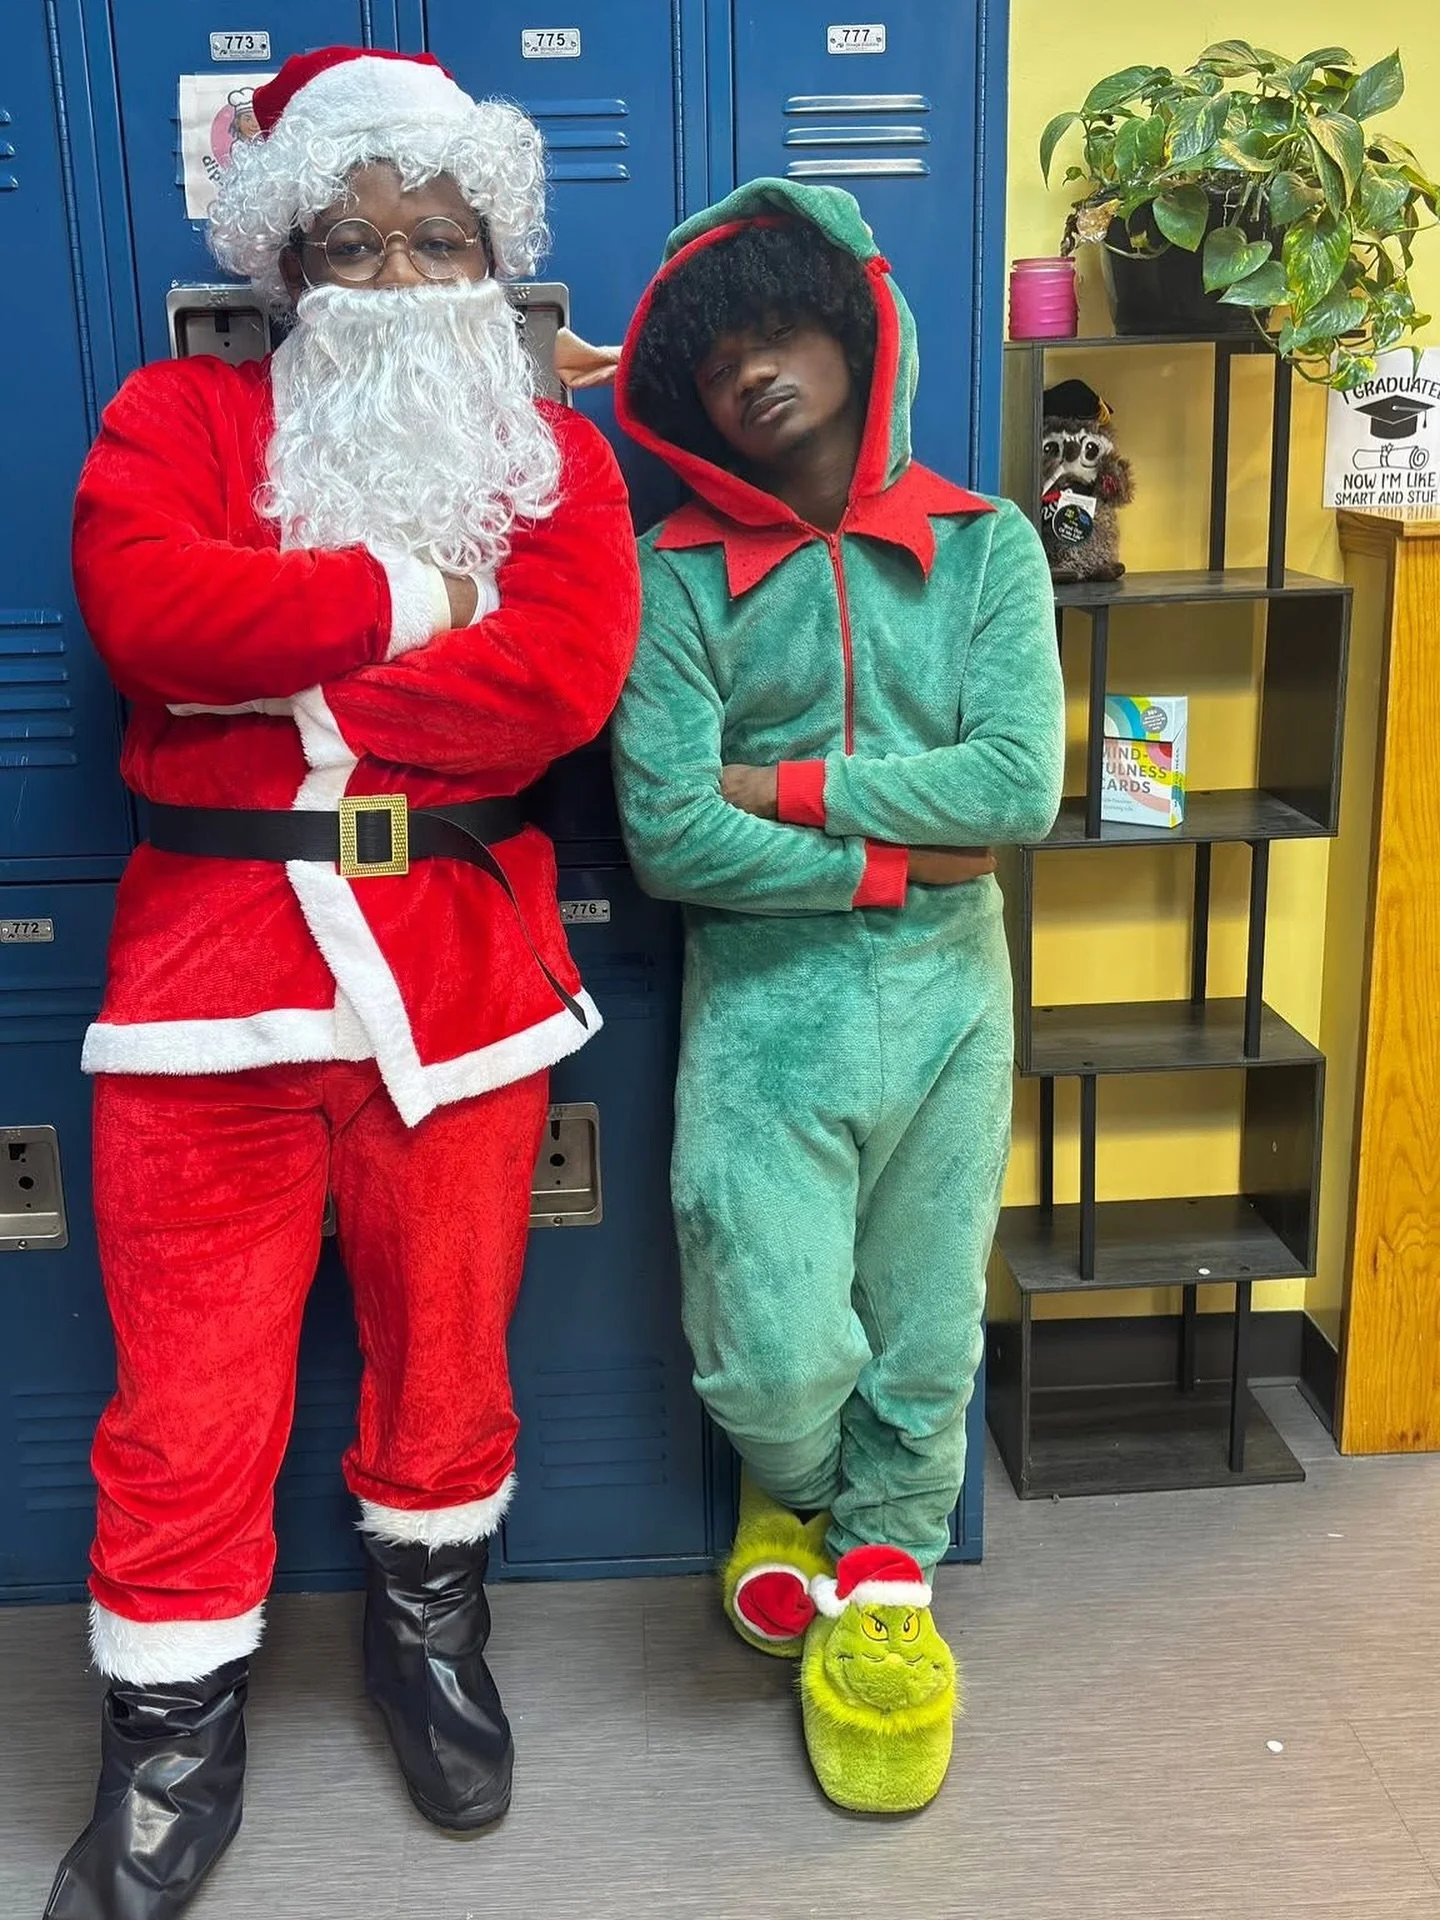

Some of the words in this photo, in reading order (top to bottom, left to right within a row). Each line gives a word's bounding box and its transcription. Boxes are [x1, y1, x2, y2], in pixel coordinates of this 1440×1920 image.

[536, 33, 565, 46] 775
[842, 29, 870, 42] 777
[224, 36, 254, 49] 773
[1352, 376, 1440, 400] GRADUATE
[1343, 473, 1377, 490] NOW
[1381, 473, 1401, 489] I'M
[1407, 472, 1436, 488] LIKE
[1334, 492, 1375, 506] SMART
[1378, 491, 1404, 505] AND
[570, 903, 597, 914] 776
[12, 922, 39, 933] 772
